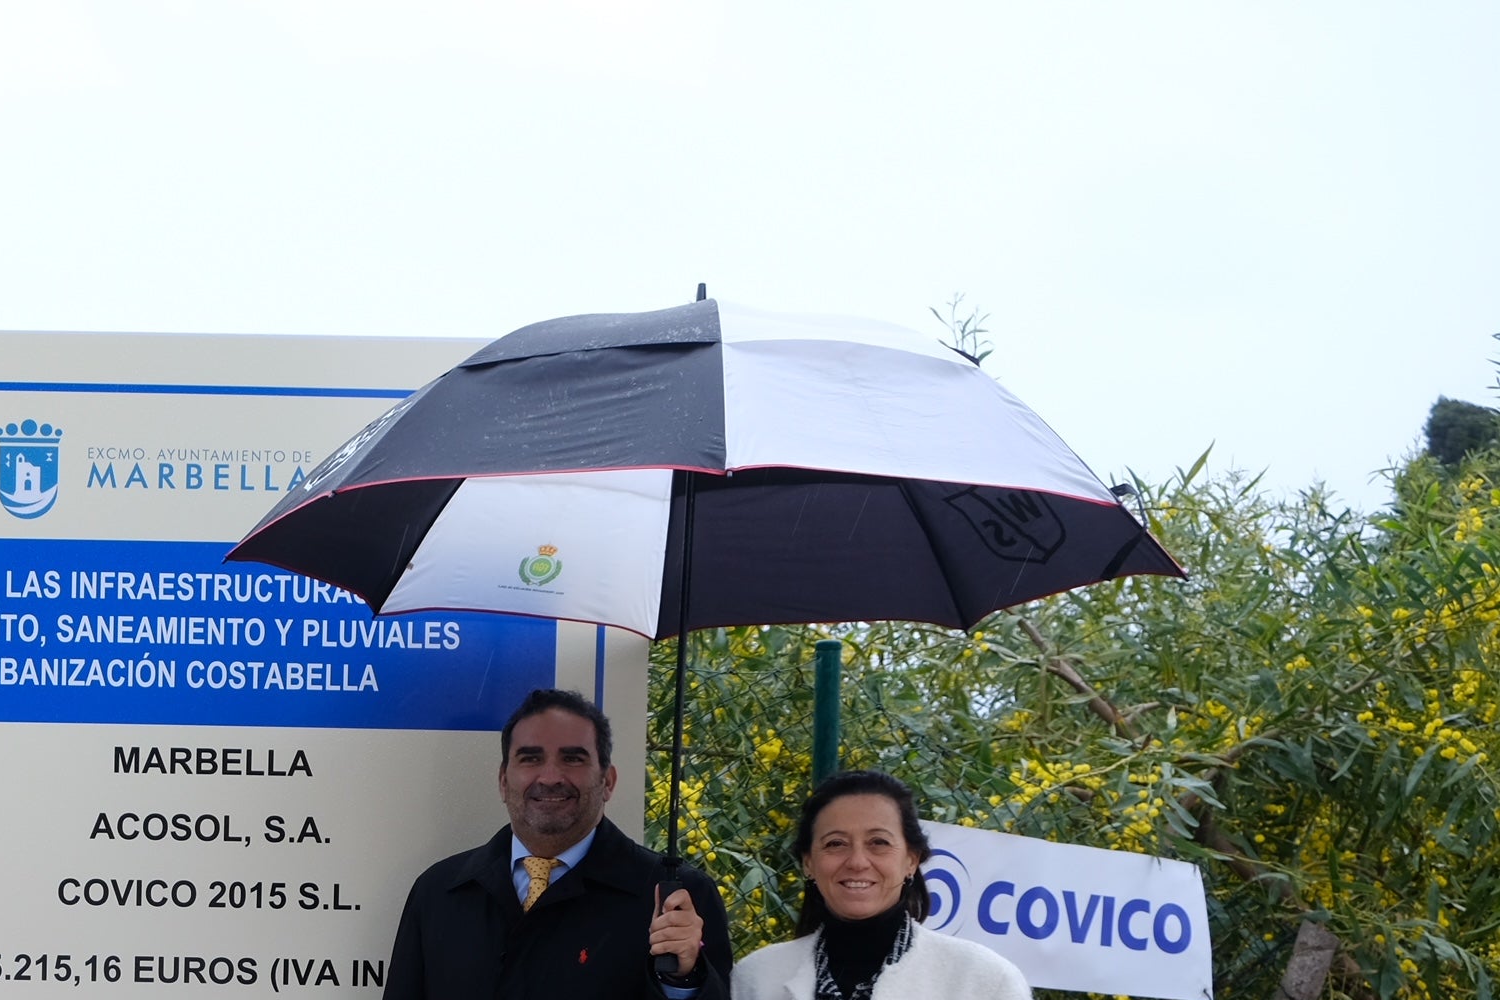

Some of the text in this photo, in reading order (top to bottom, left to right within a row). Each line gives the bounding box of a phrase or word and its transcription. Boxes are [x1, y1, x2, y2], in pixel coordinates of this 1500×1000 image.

[87, 447, 312, 463] EXCMO. AYUNTAMIENTO DE
[86, 461, 308, 492] MARBELLA
[6, 570, 61, 599] LAS
[56, 614, 266, 647] SANEAMIENTO
[274, 618, 294, 647] Y
[302, 619, 461, 650] PLUVIALES
[186, 660, 379, 692] COSTABELLA
[113, 746, 314, 777] MARBELLA
[89, 812, 332, 848] ACOSOL, S.A.
[57, 878, 362, 911] COVICO 2015 S.L.
[977, 880, 1192, 955] COVICO
[134, 955, 258, 985] EUROS
[270, 957, 341, 993] (IVA
